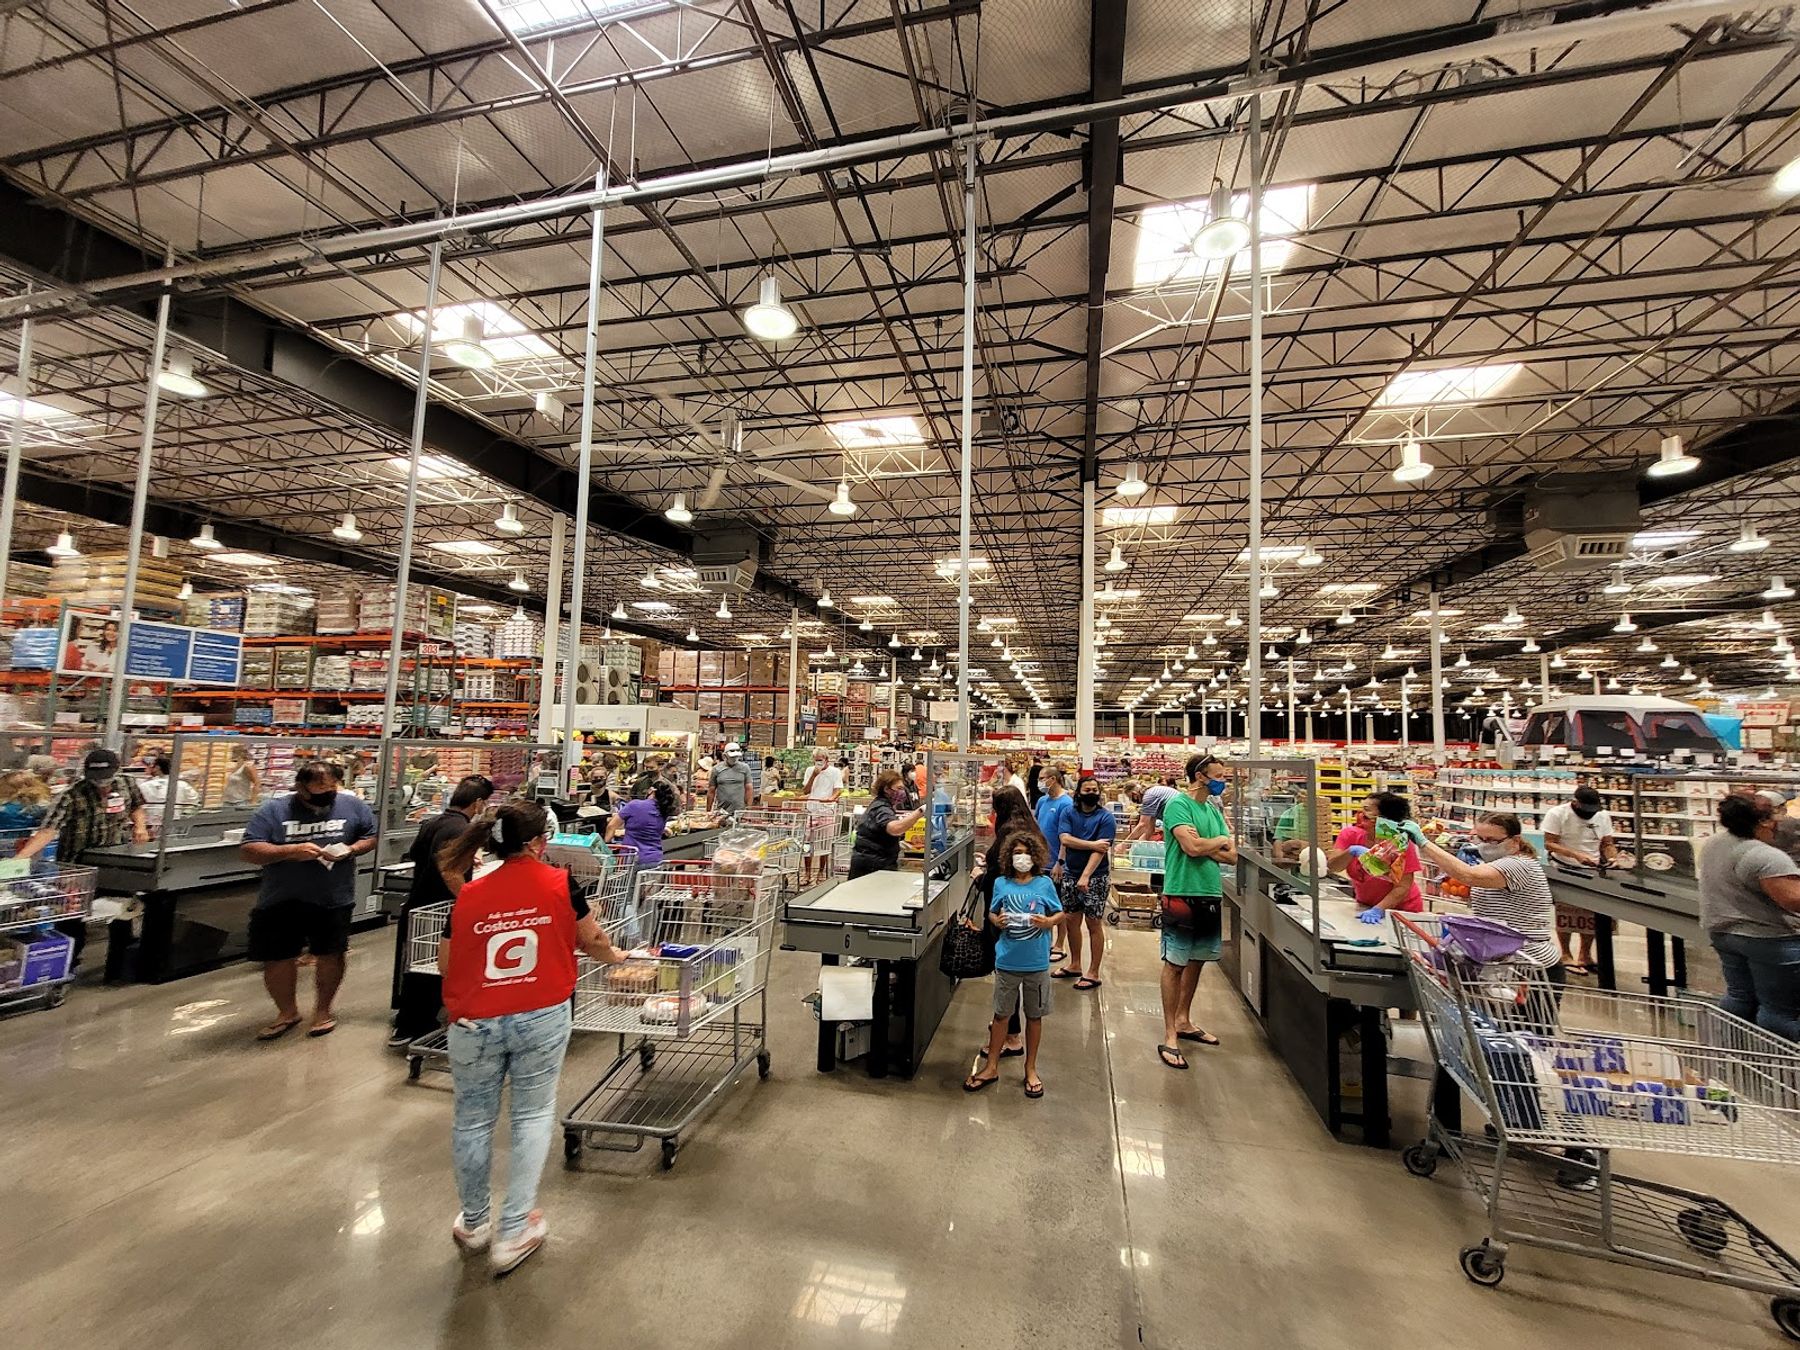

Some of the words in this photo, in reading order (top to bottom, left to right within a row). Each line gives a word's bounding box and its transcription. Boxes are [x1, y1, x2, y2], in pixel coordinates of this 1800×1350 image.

[422, 645, 438, 653] 303
[282, 820, 347, 835] Turner
[473, 916, 552, 934] Costco.com
[1557, 915, 1594, 930] CLOS
[844, 933, 851, 949] 6
